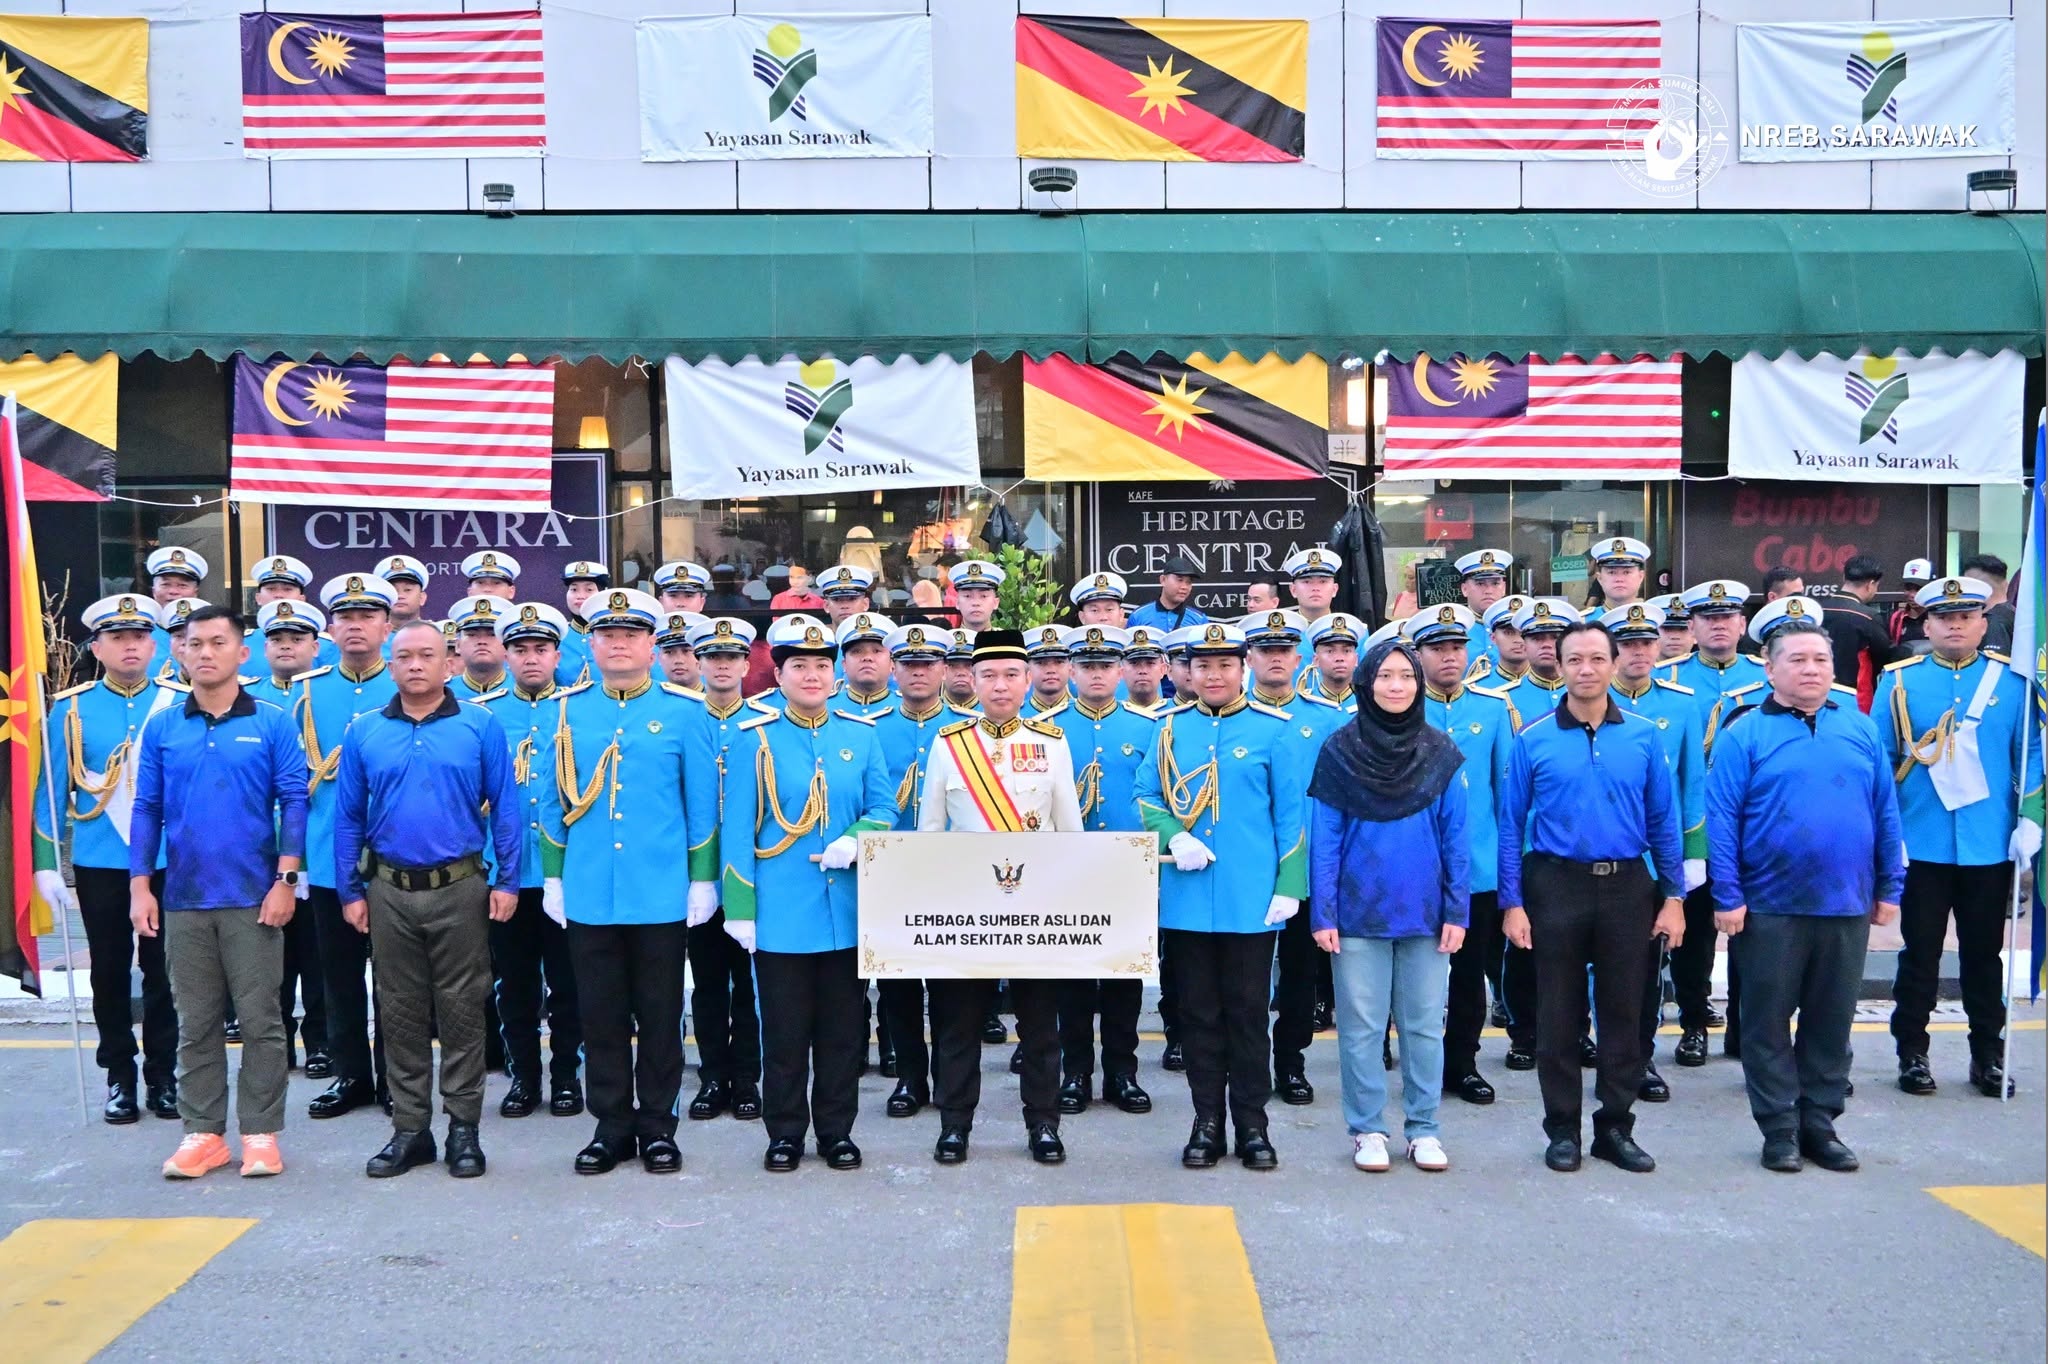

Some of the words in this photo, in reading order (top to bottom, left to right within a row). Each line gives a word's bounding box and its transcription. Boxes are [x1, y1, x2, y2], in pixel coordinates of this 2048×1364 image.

[704, 131, 783, 151] Yayasan
[788, 129, 873, 146] Sarawak
[1792, 449, 1869, 471] Yayasan
[1875, 452, 1960, 470] Sarawak
[736, 466, 819, 486] Yayasan
[825, 458, 914, 478] Sarawak
[1128, 491, 1153, 500] KAFE
[1732, 487, 1881, 526] Bumbu
[1141, 509, 1305, 532] HERITAGE
[304, 511, 572, 549] CENTARA
[1108, 541, 1329, 575] CENTRA
[1753, 532, 1858, 573] Cabe
[1552, 561, 1585, 570] CLOSED
[1426, 575, 1460, 583] CLOSED
[1434, 582, 1453, 590] FOR
[1425, 589, 1462, 597] PRIVATE
[1804, 584, 1839, 597] ress
[1194, 593, 1249, 608] CAFE
[905, 914, 976, 927] LEMBAGA
[979, 914, 1039, 927] SUMBER
[1043, 914, 1076, 927] ASLI
[1081, 914, 1112, 927] DAN
[913, 933, 957, 946] ALAM
[960, 933, 1023, 946] SEKITAR
[1026, 933, 1103, 946] SARAWAK
